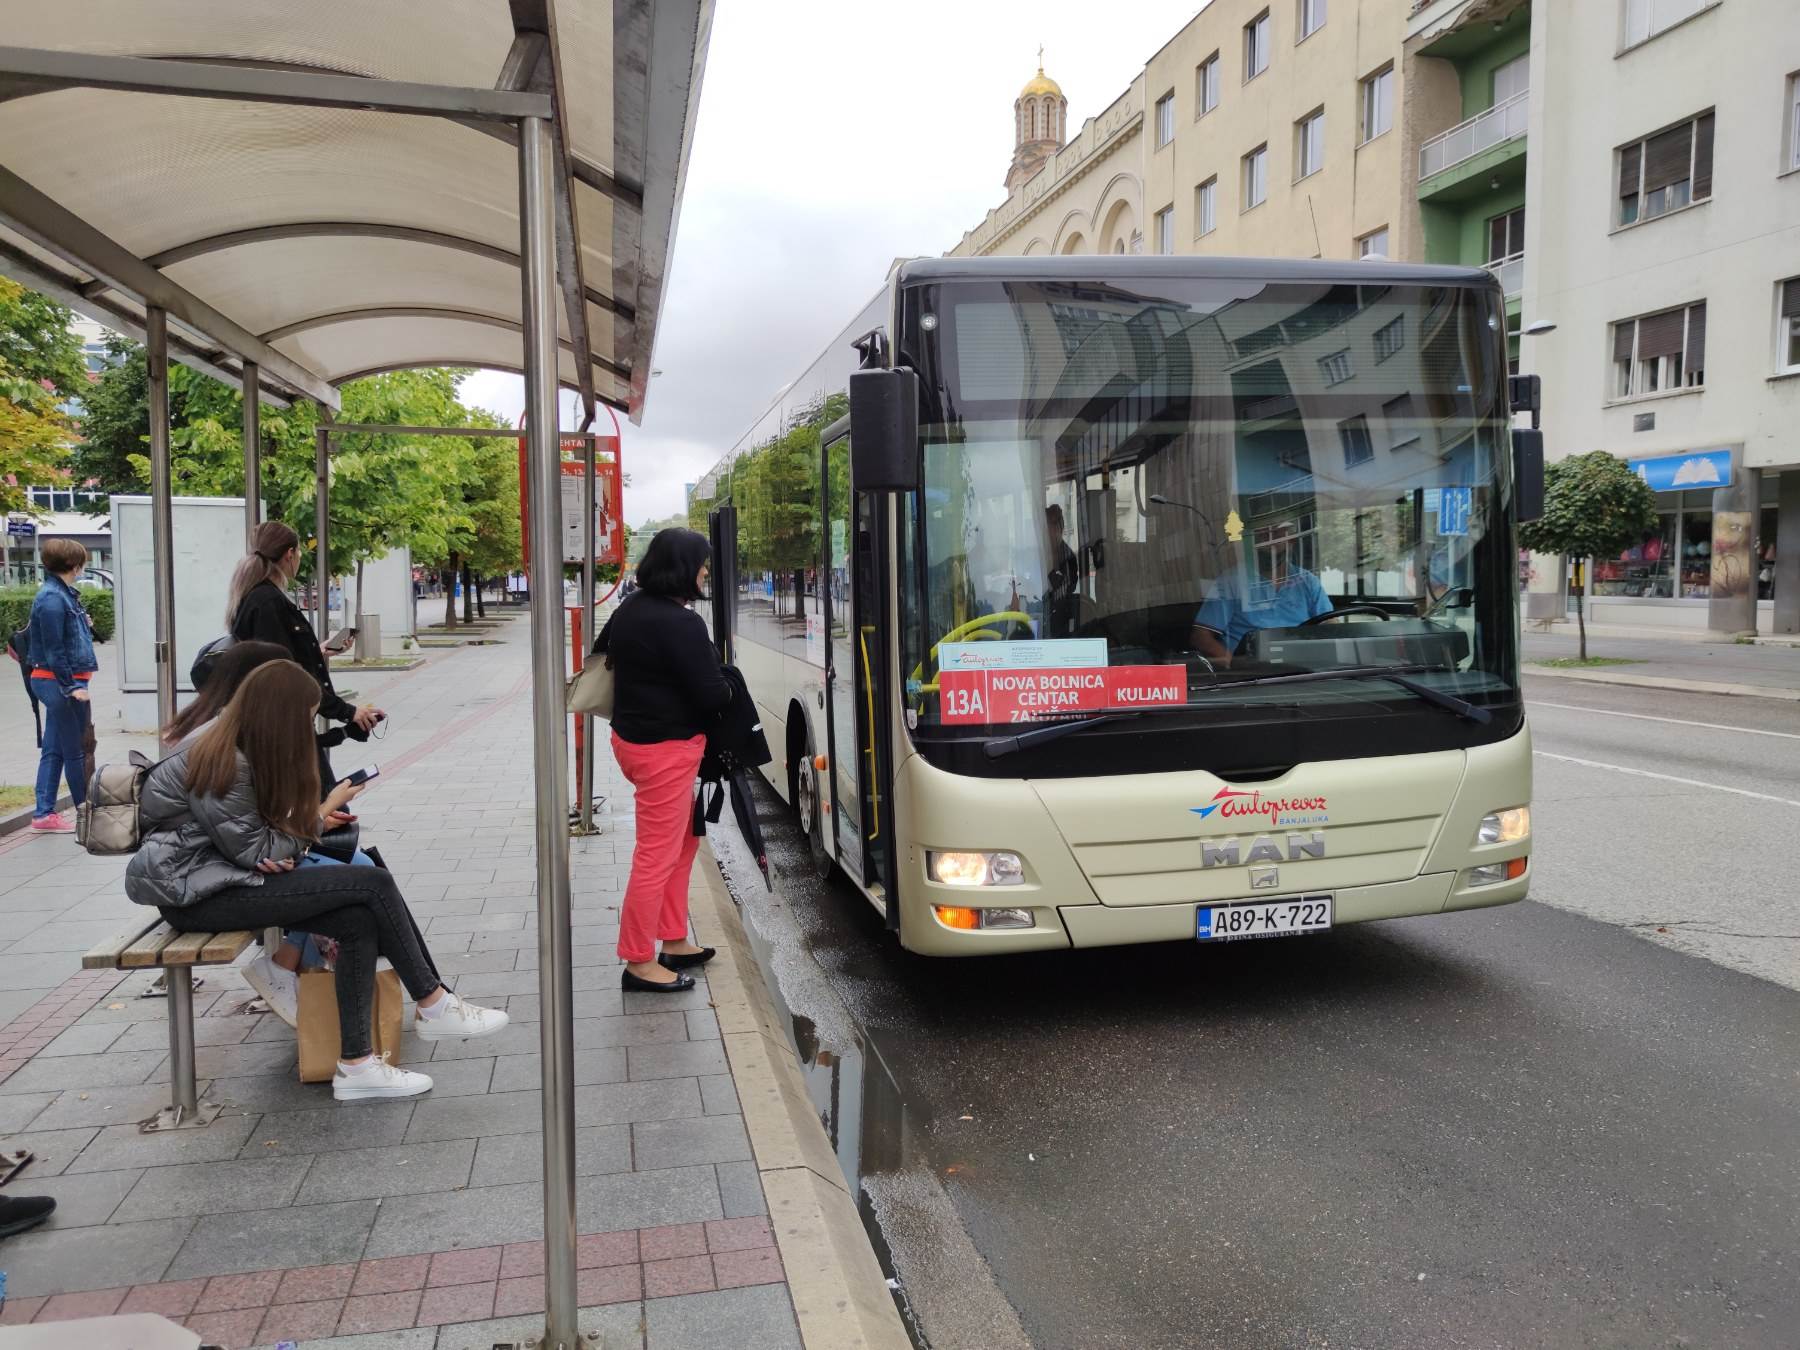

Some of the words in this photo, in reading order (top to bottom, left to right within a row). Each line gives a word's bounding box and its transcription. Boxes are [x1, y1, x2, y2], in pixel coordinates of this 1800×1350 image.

[992, 676, 1036, 692] NOVA
[1040, 674, 1105, 690] BOLNICA
[1116, 686, 1179, 703] KULJANI
[946, 688, 985, 716] 13A
[1018, 691, 1080, 706] CENTAR
[1219, 789, 1328, 826] autoprevoz
[1200, 831, 1326, 867] MAN
[1214, 903, 1327, 934] A89-K-722
